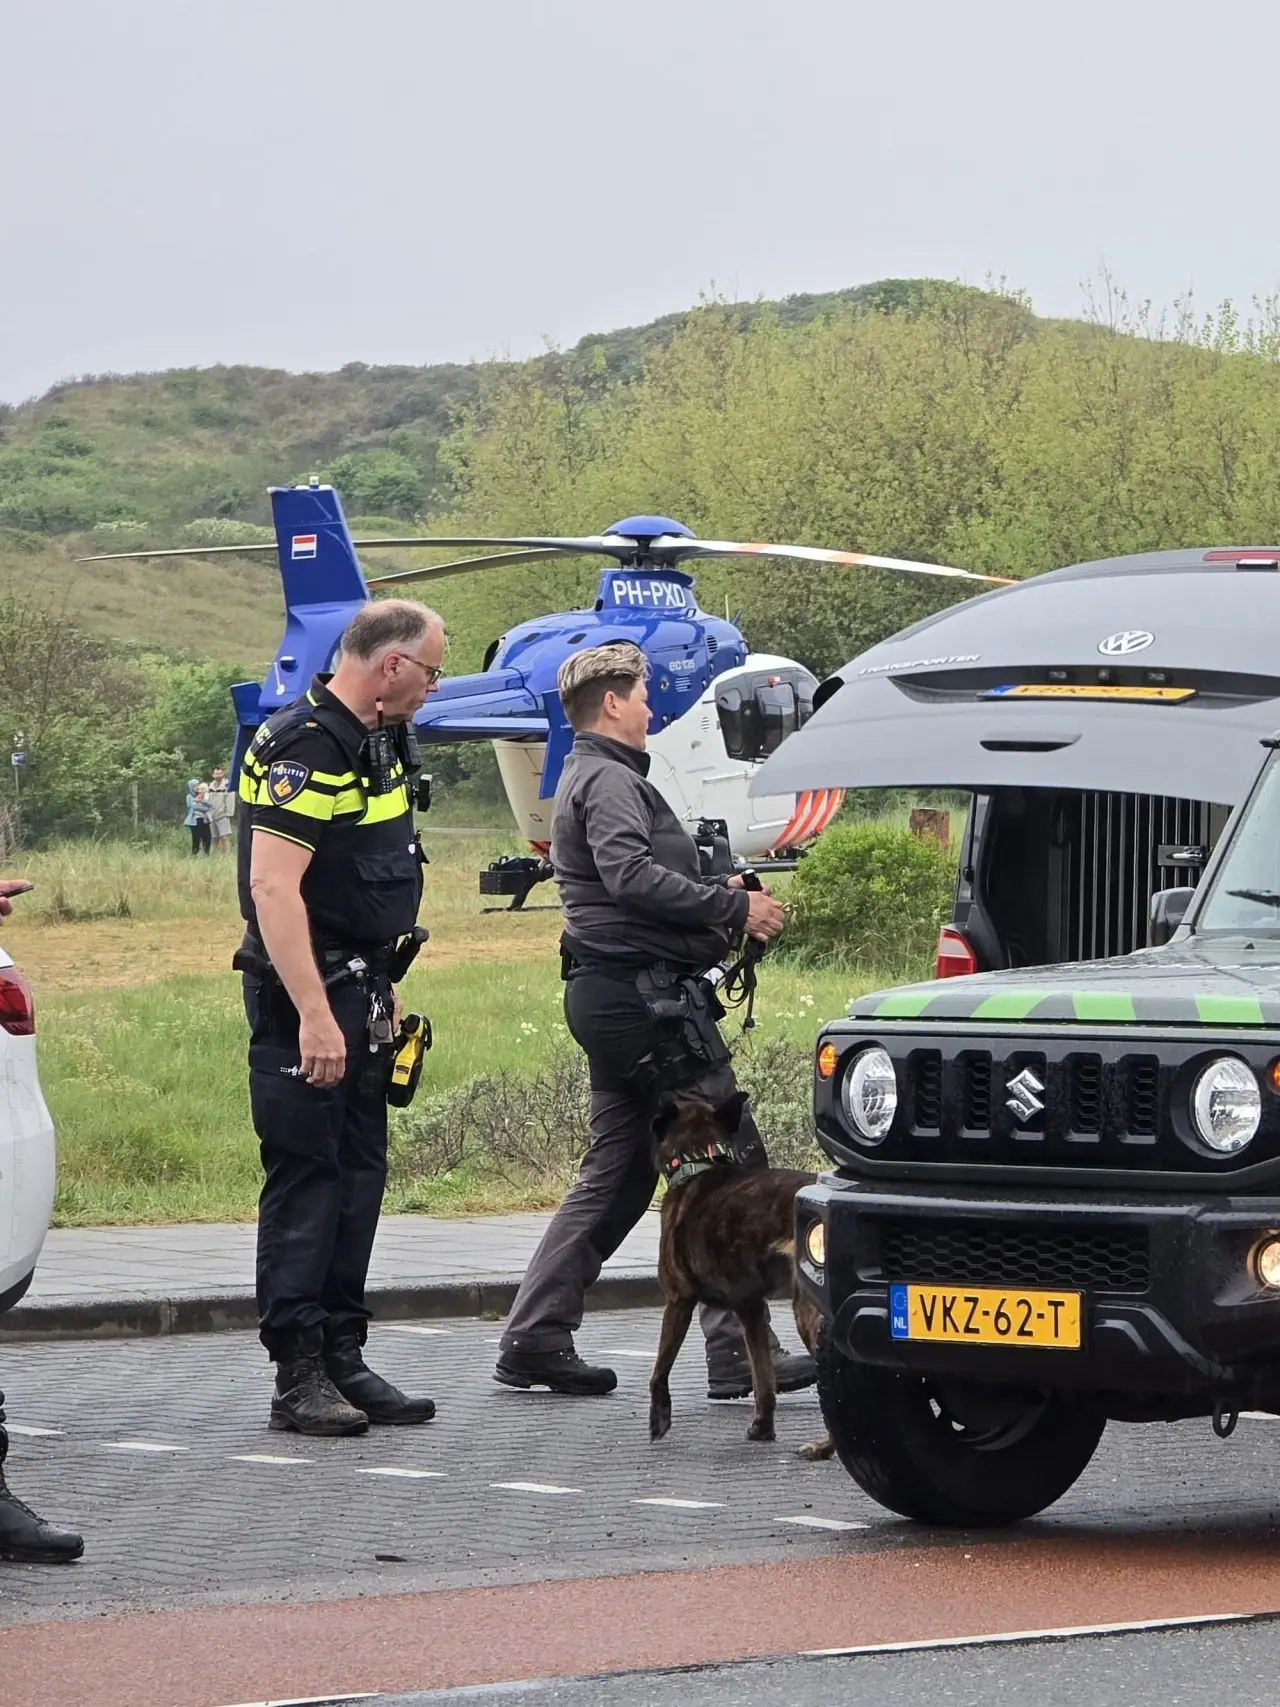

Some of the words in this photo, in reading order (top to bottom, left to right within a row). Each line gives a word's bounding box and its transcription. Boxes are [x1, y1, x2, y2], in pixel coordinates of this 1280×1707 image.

[612, 580, 687, 608] PH-PXD
[893, 1316, 908, 1330] NL
[918, 1293, 1066, 1338] VKZ-62-T
